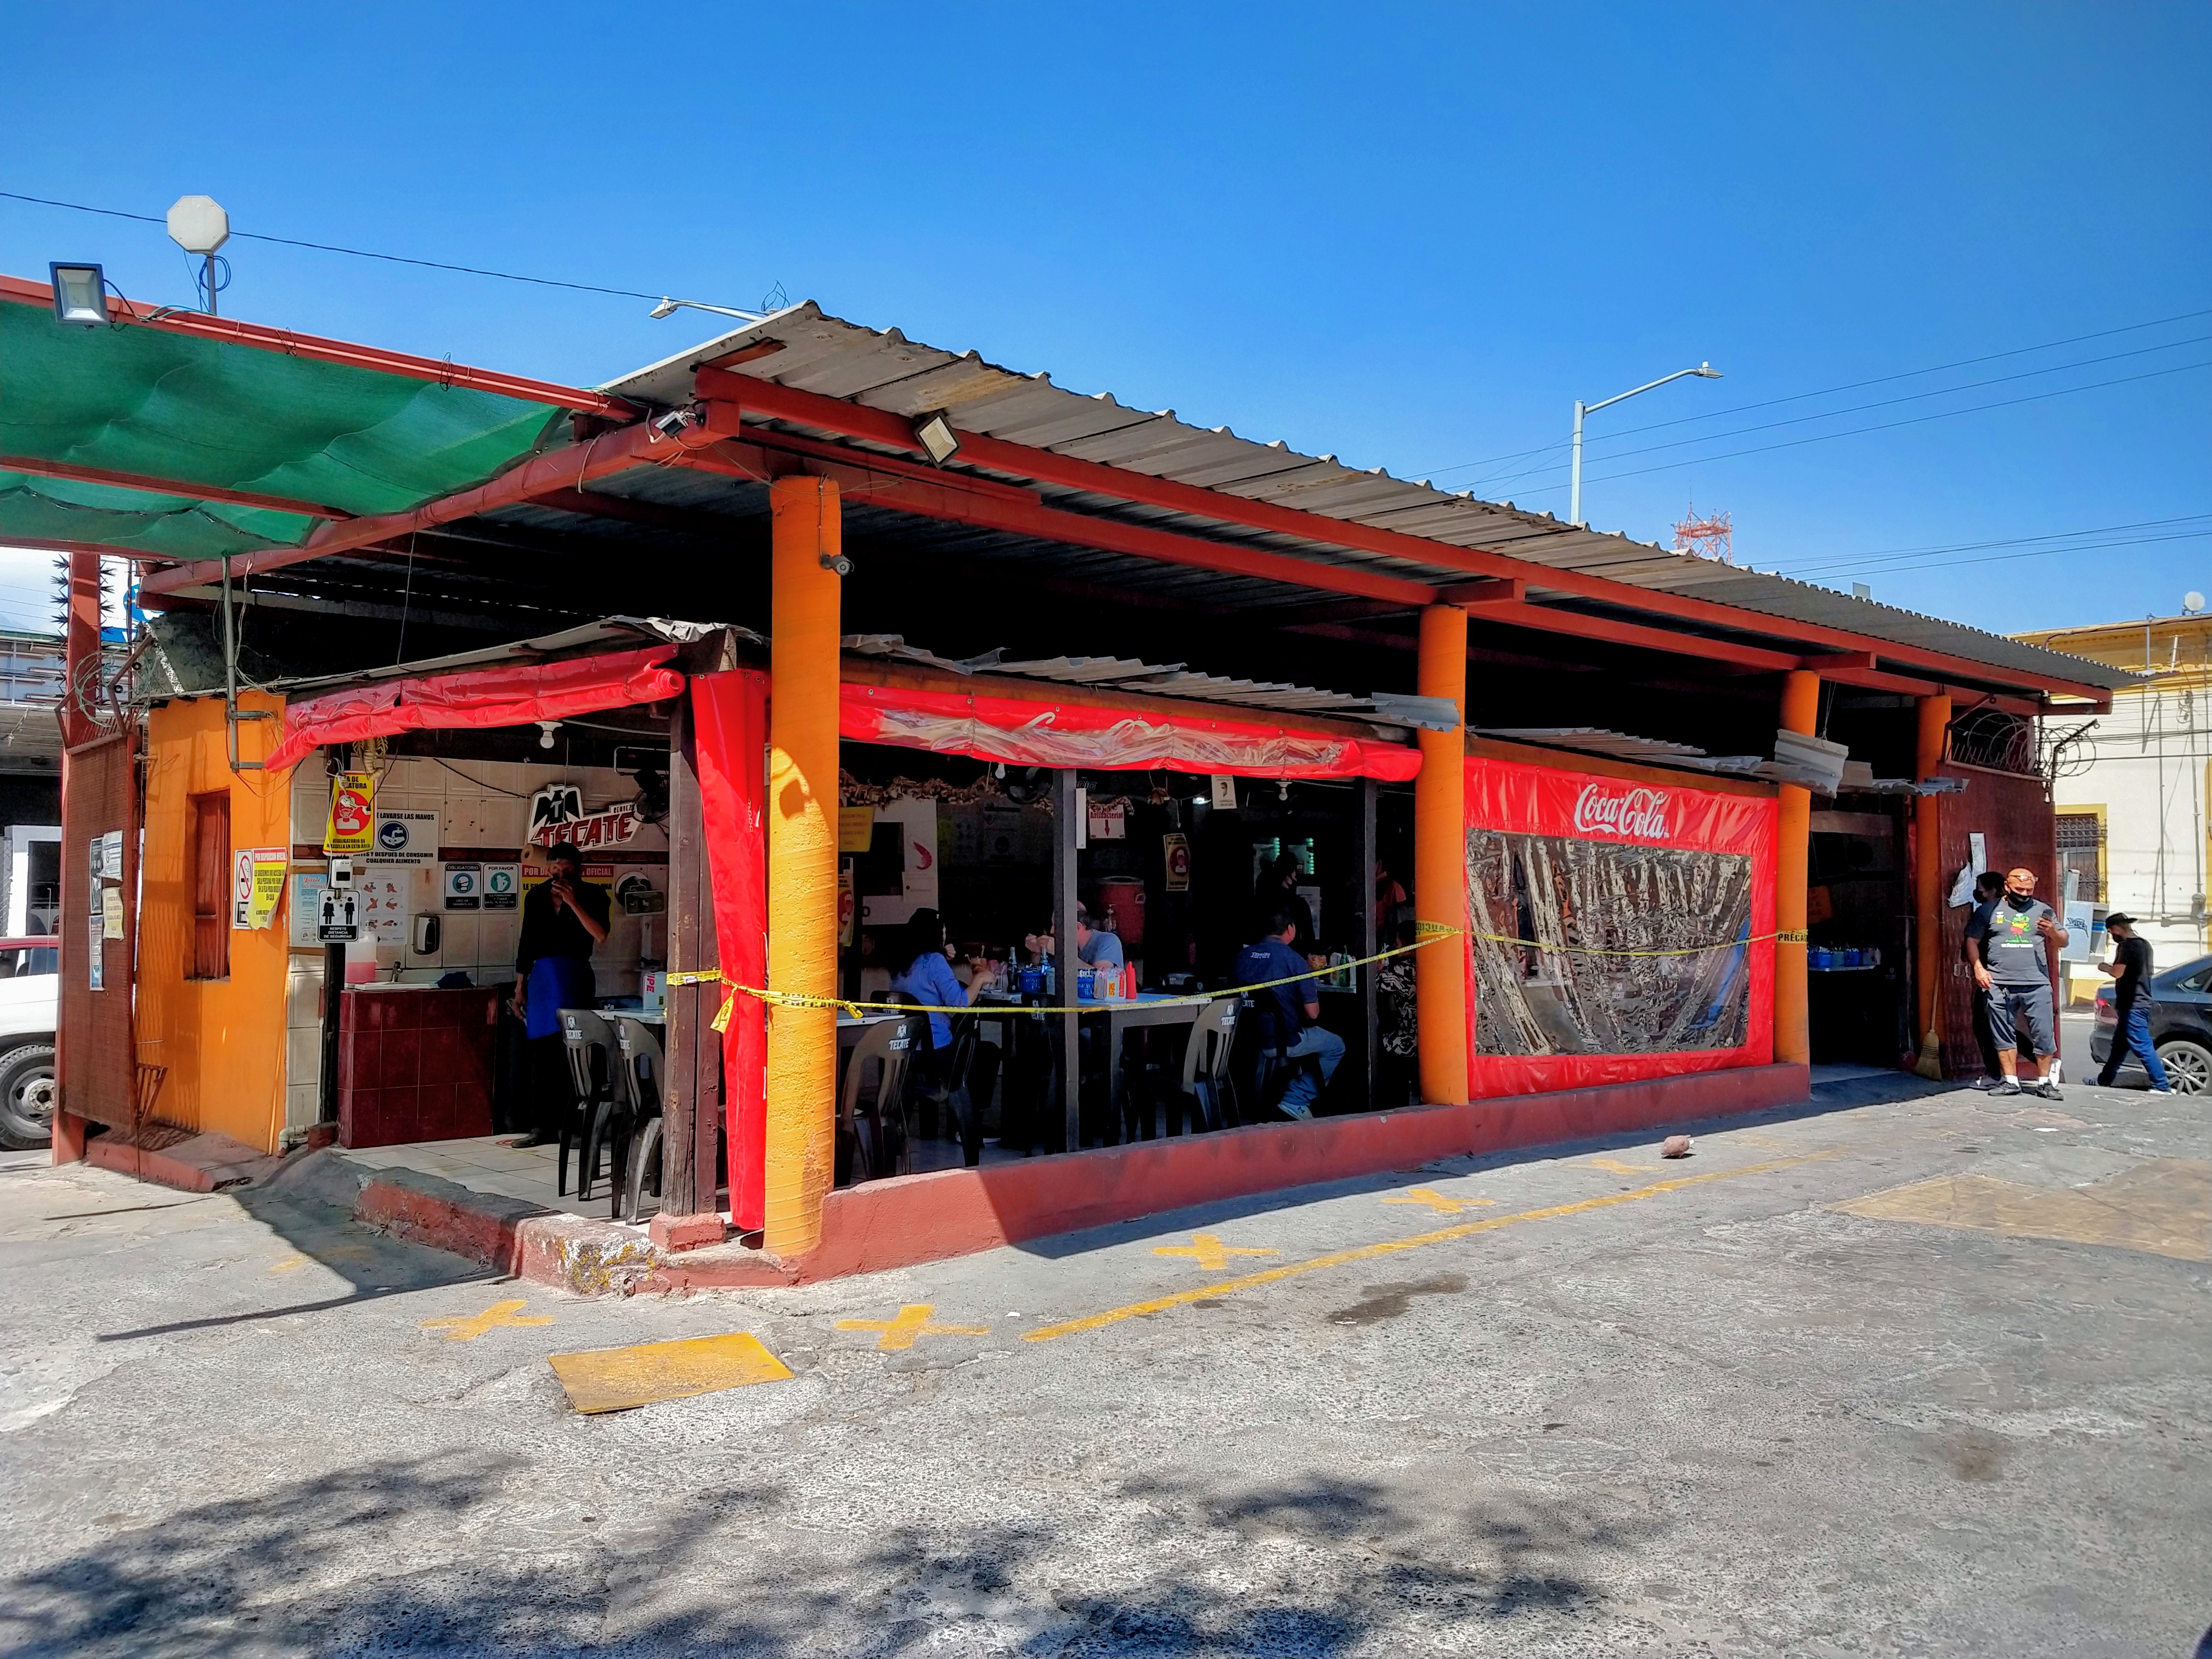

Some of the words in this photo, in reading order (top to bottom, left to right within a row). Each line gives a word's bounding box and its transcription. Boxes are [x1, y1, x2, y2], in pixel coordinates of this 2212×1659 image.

[1574, 783, 1668, 839] Coca-Cola
[531, 812, 634, 848] TECATE
[524, 867, 539, 876] POR
[566, 1029, 583, 1040] TECATE
[619, 1039, 631, 1050] TECATE
[889, 1038, 911, 1051] TECATE
